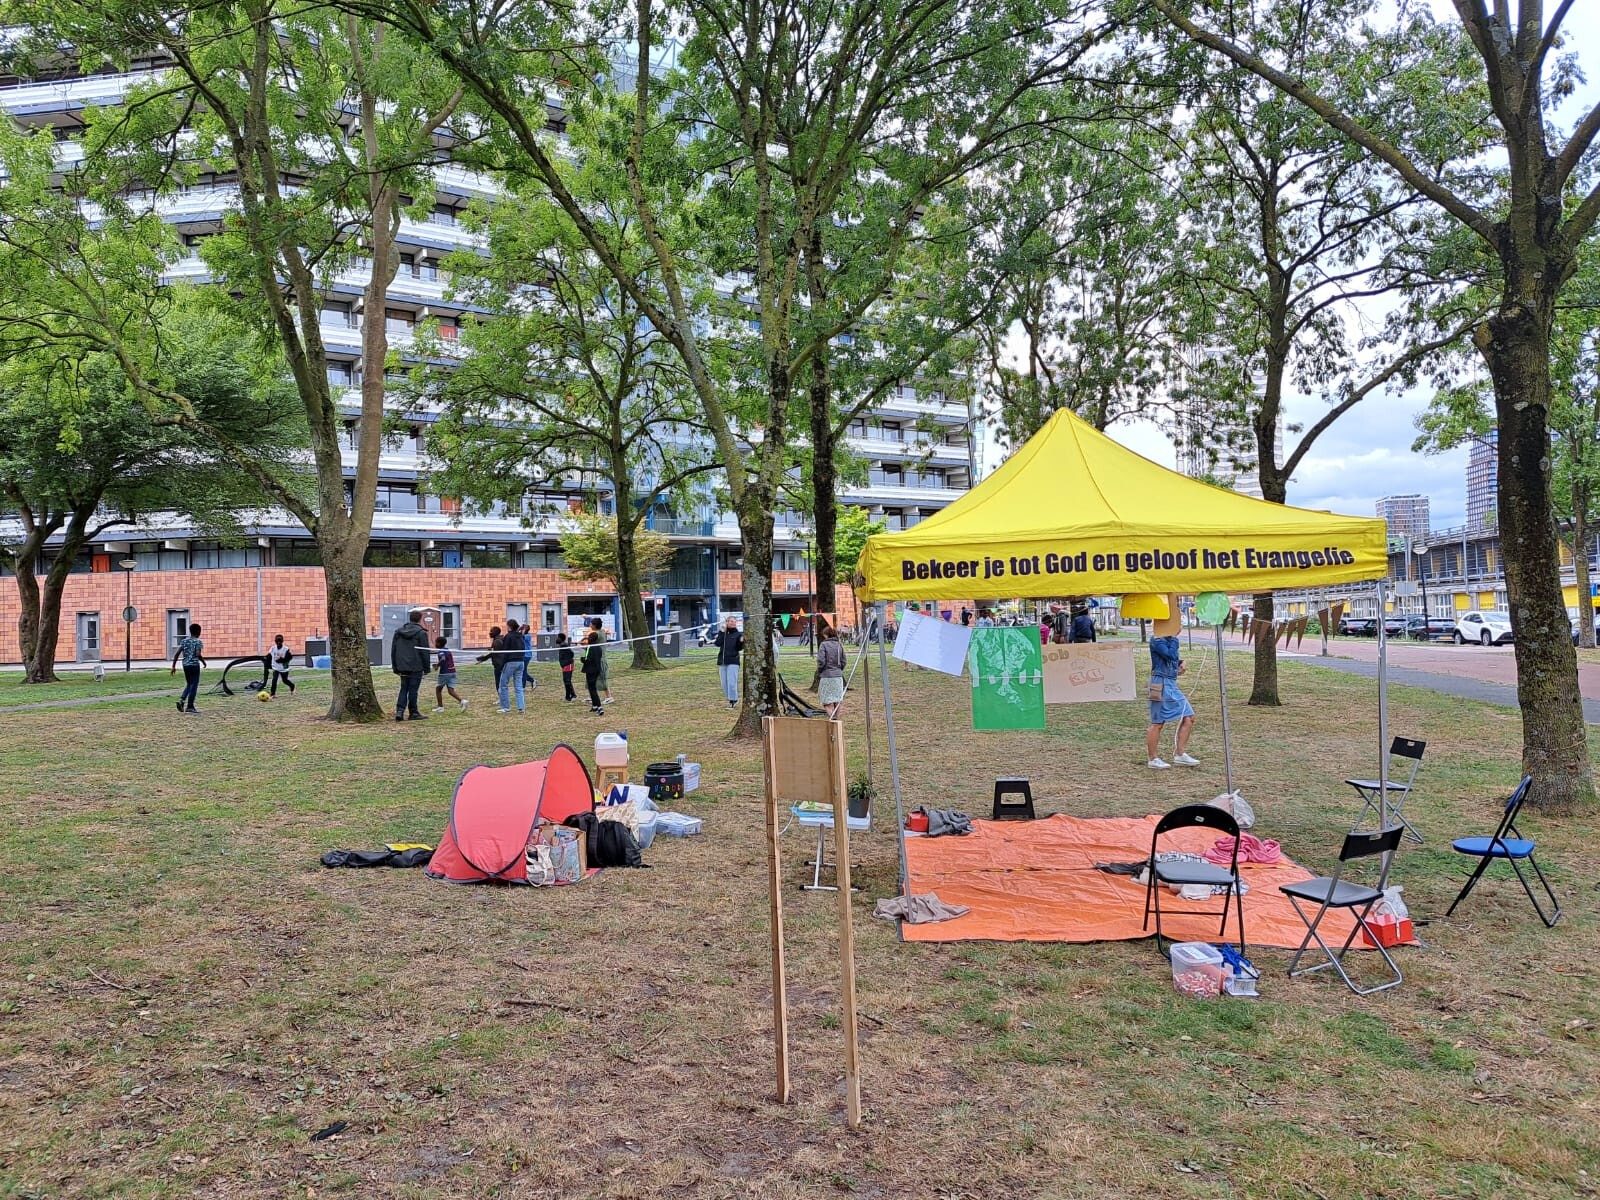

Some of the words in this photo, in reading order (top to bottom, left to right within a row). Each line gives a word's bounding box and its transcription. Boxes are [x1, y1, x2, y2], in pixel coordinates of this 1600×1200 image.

[902, 558, 979, 580] Bekeer
[984, 556, 1005, 579] je
[1009, 555, 1040, 576] tot
[1045, 551, 1087, 574] God
[1092, 553, 1120, 571] en
[1125, 548, 1198, 573] geloof
[1203, 548, 1240, 569] het
[1245, 547, 1355, 569] Evangelie
